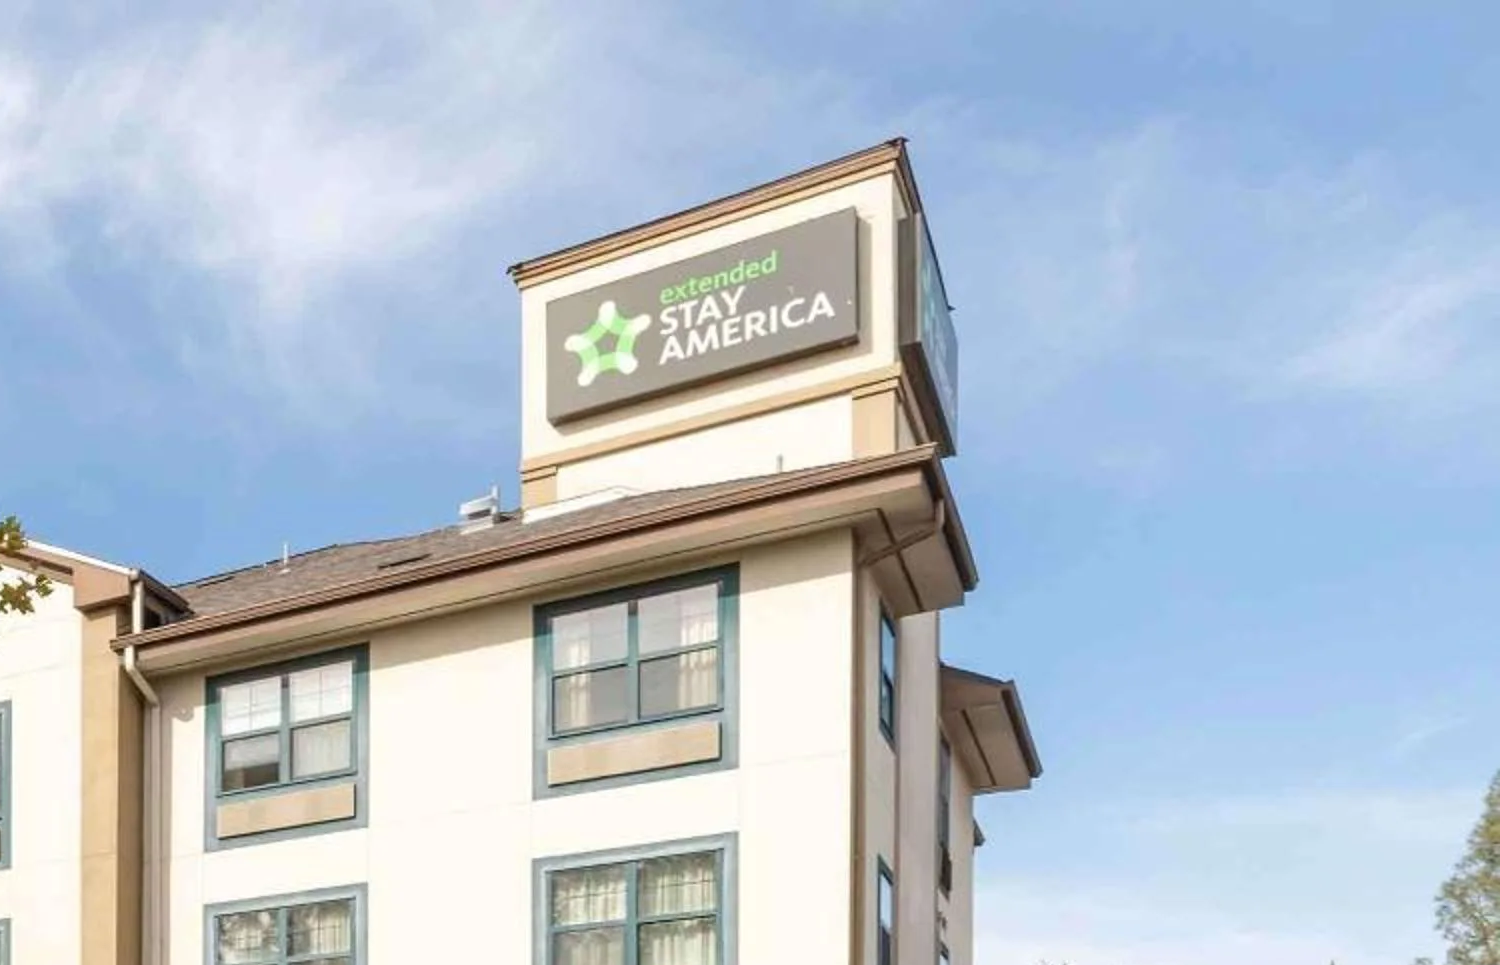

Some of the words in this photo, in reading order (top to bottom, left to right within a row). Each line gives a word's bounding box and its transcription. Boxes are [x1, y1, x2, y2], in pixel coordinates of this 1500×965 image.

[660, 251, 778, 304] extended
[659, 292, 835, 365] AMERICA
[660, 286, 746, 335] STAY
